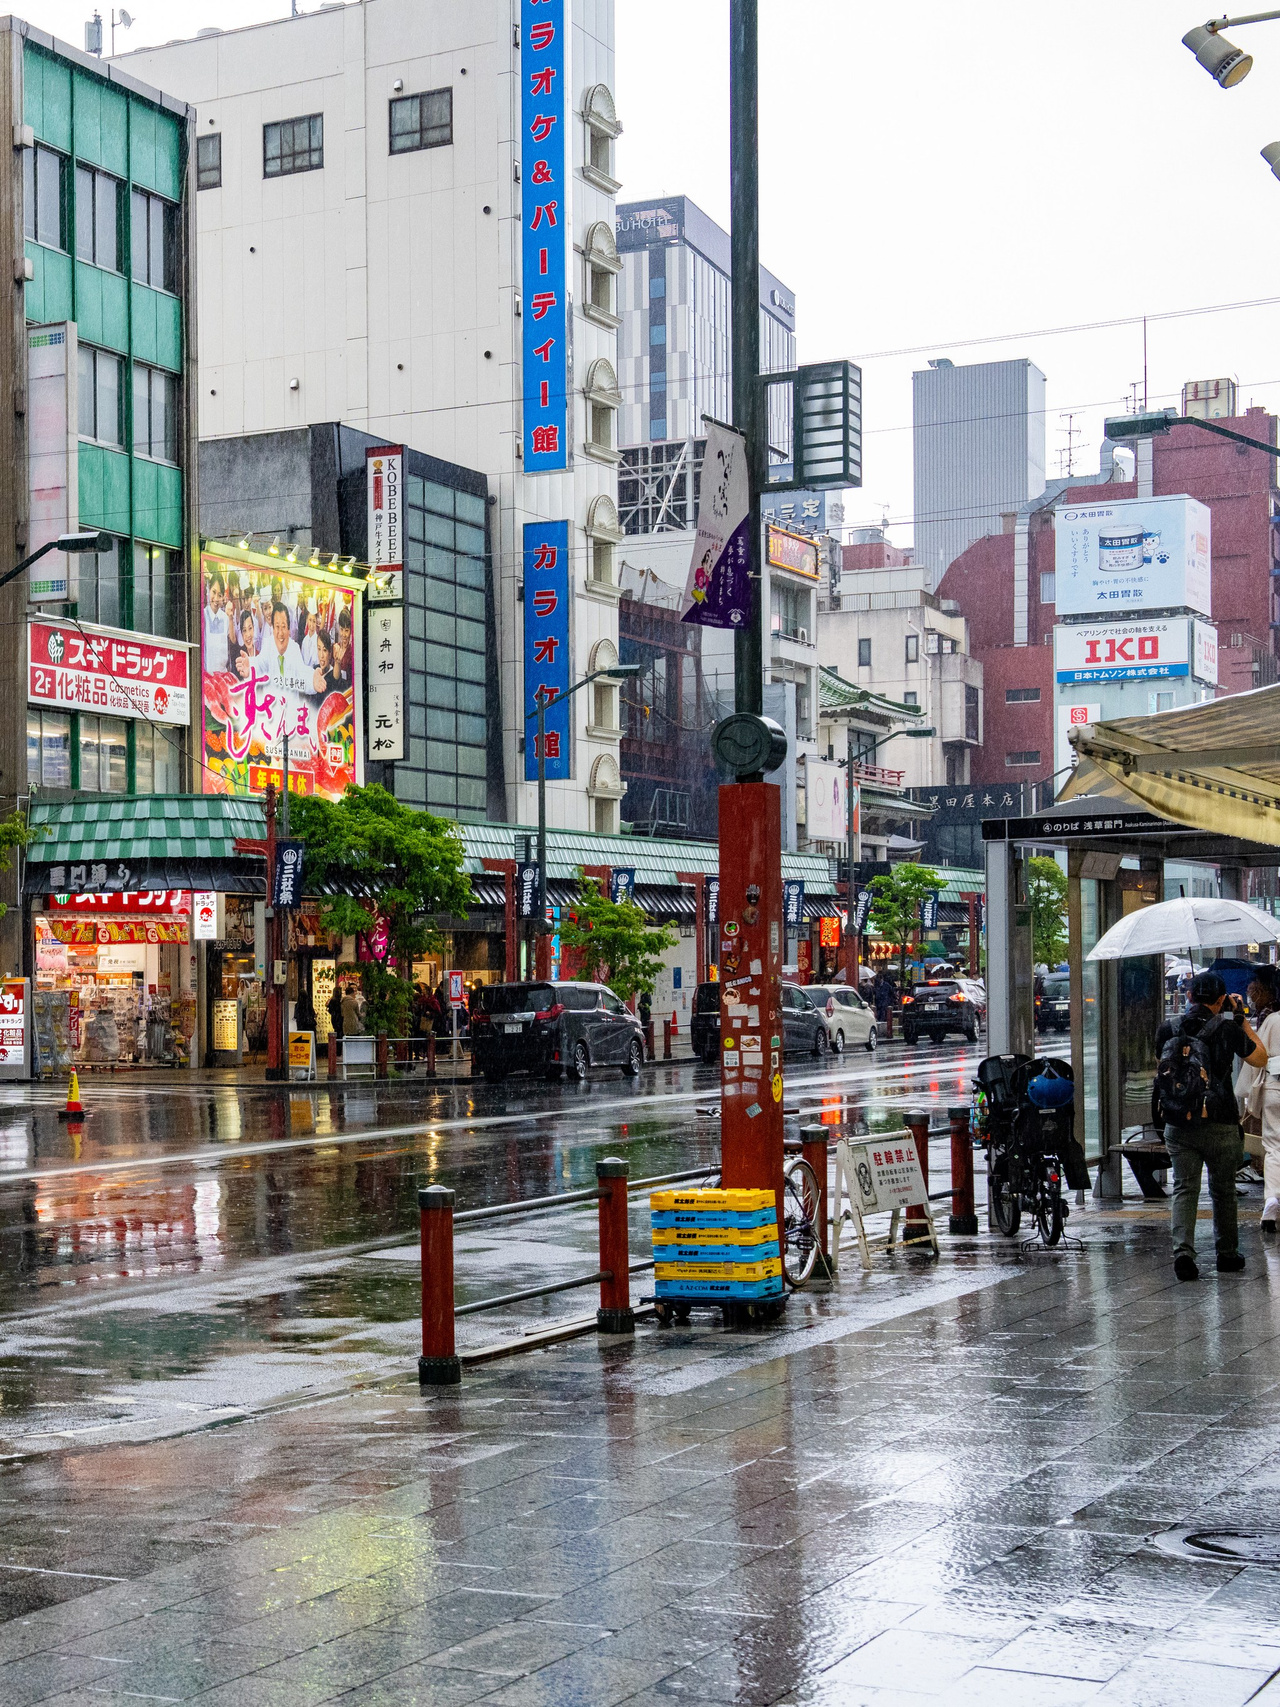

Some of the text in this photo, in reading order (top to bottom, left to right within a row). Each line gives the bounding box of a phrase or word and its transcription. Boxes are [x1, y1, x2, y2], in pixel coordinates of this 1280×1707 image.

[530, 0, 559, 454] ラオケ&パーティー館
[1079, 510, 1114, 519] 太田胃散
[1071, 529, 1079, 578] いいくすりです
[1082, 528, 1090, 564] ありがとう
[1104, 537, 1139, 547] 太田胃散
[1097, 589, 1143, 600] 太田胃散
[1076, 624, 1168, 637] ベアリングで社会の軸を支える
[68, 638, 174, 680] スギドラッグ
[378, 638, 394, 674] 舟和
[1084, 635, 1159, 664] IKO
[34, 670, 52, 695] 2F
[273, 676, 306, 691] つきじ喜代村
[1074, 667, 1170, 680] 日本トムソン株式会社
[57, 672, 108, 706] 化粧品
[109, 680, 150, 698] Cosmetics
[373, 714, 395, 751] 元松
[929, 792, 1014, 809] 黒田屋本店
[1083, 819, 1123, 830] 浅草雷門
[279, 864, 295, 905] 三社祭
[786, 895, 798, 923] 三社祭
[872, 1147, 915, 1167] 駐輪禁止
